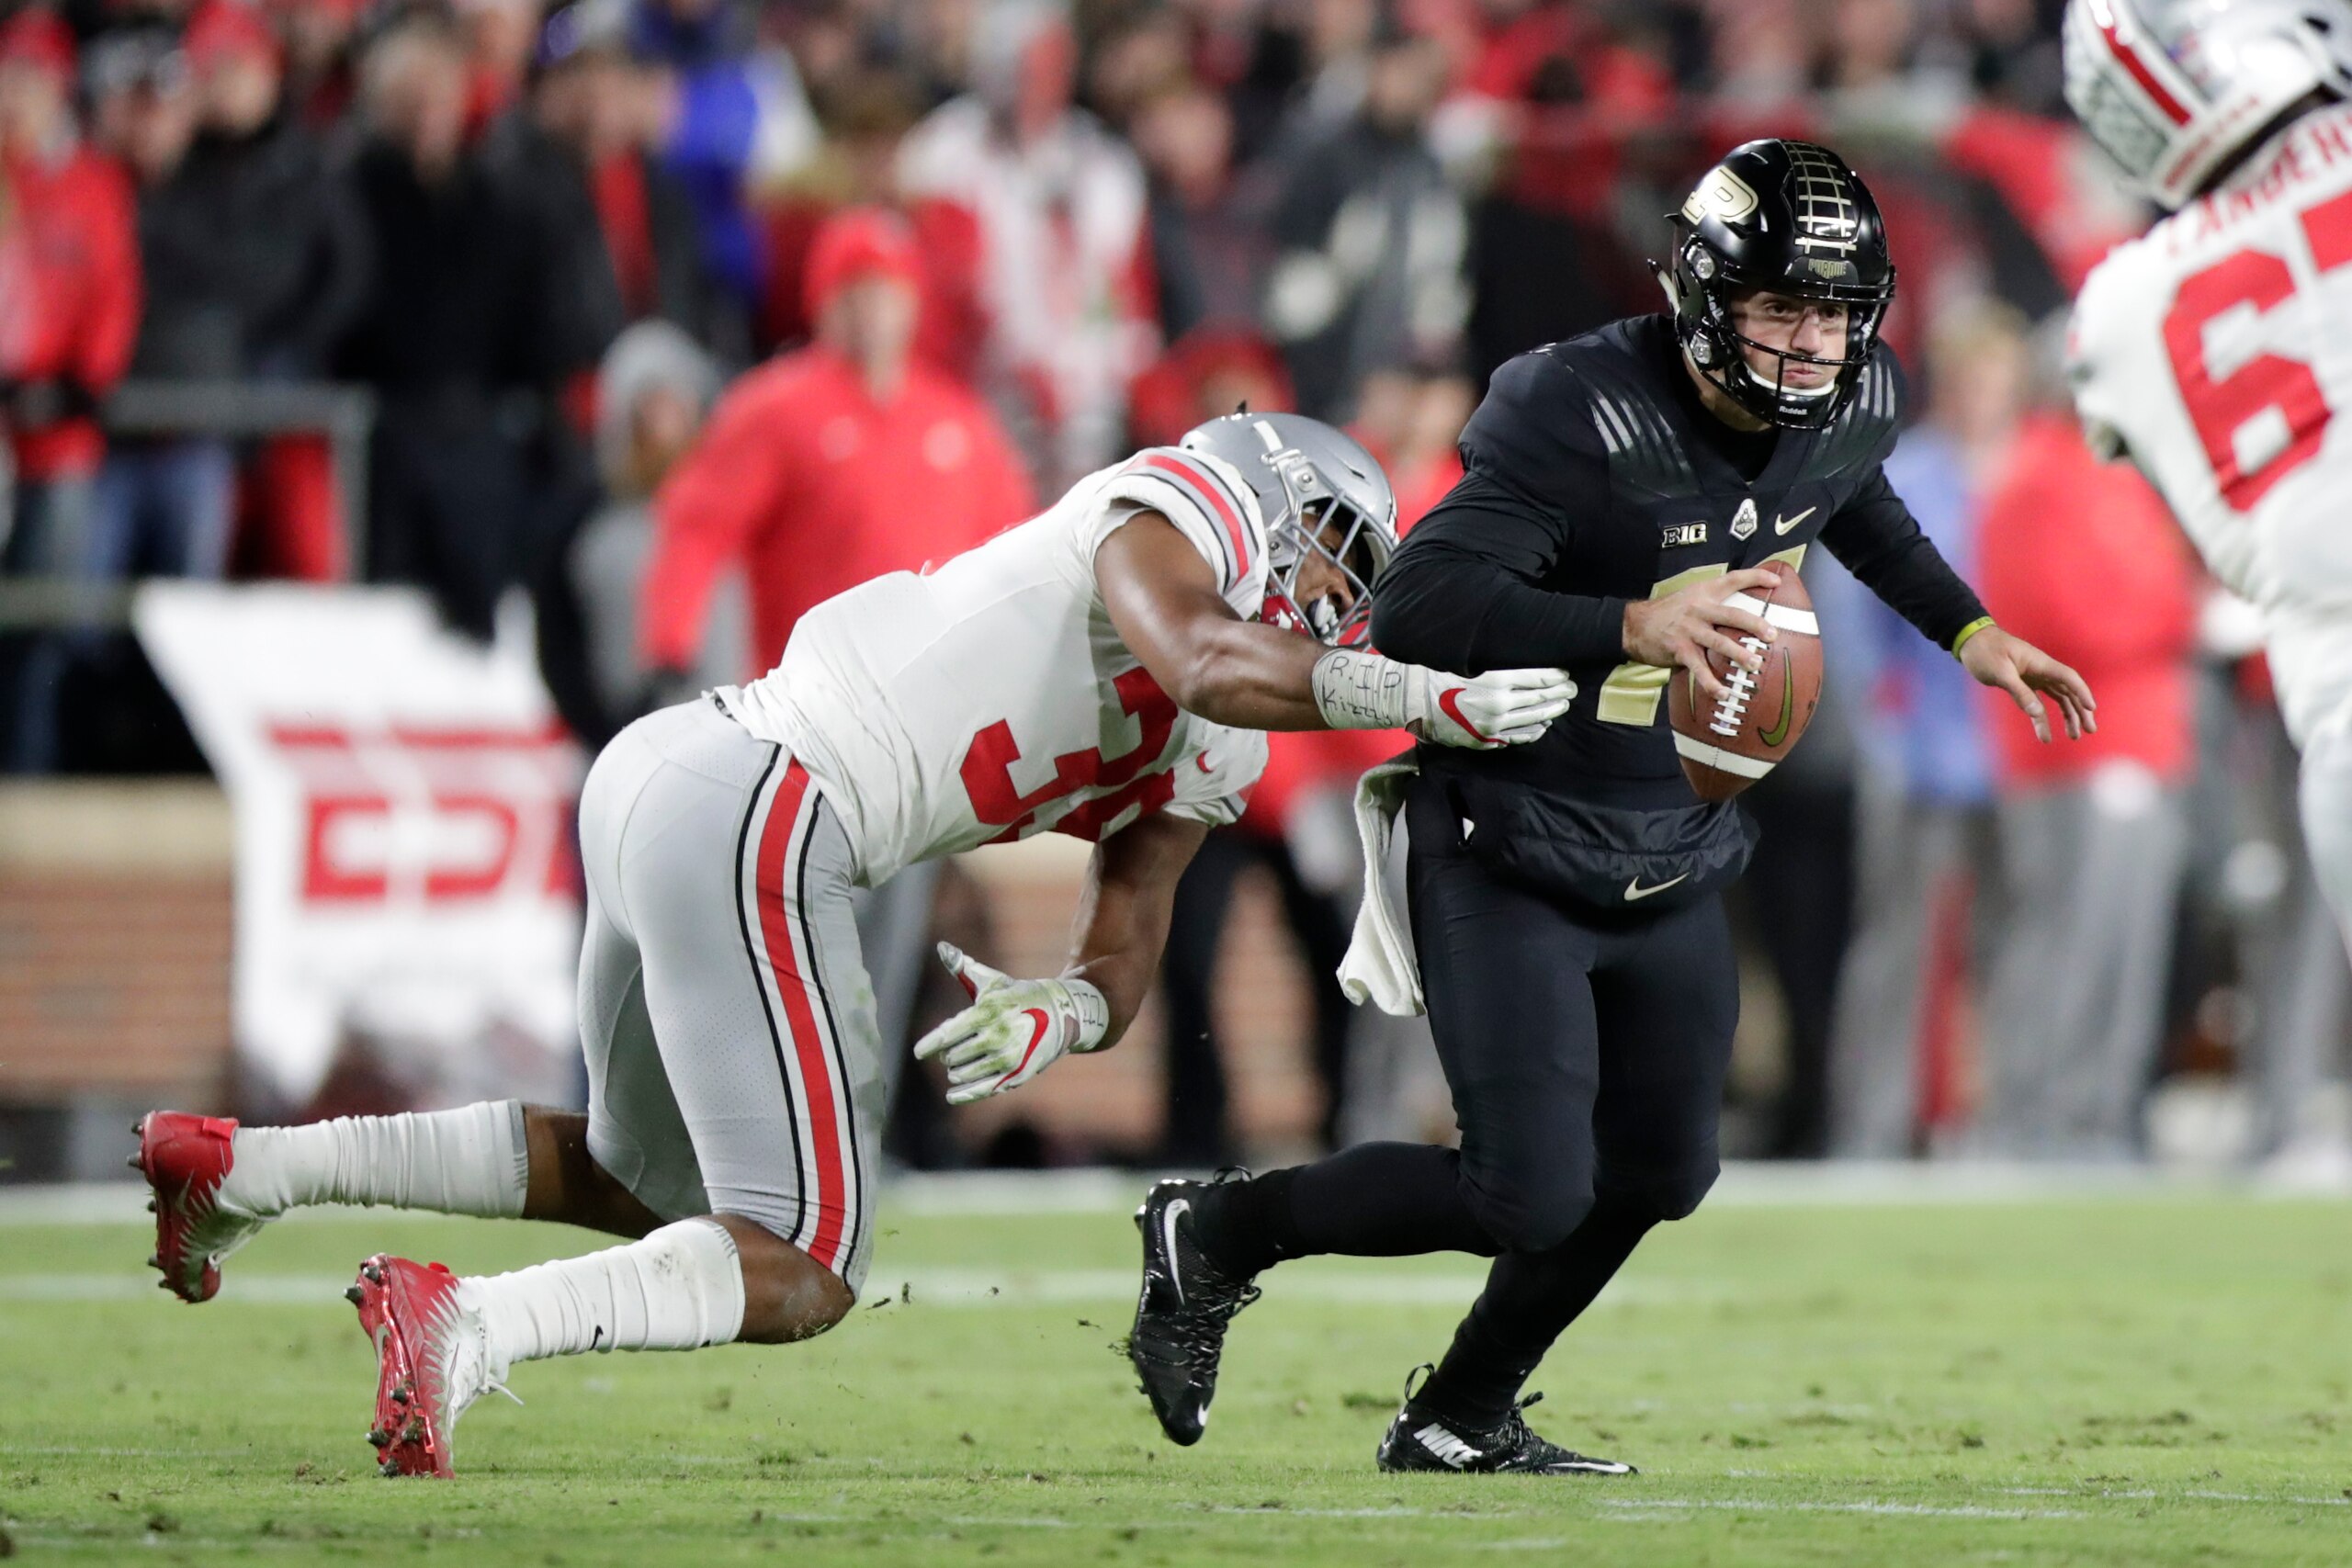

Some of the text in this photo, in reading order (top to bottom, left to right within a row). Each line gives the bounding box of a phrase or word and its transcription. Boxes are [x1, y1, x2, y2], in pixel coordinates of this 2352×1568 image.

[1681, 165, 1758, 225] P
[1779, 405, 1808, 415] Riddell
[1662, 520, 1708, 548] BIG
[1413, 1422, 1483, 1469] NIKE
